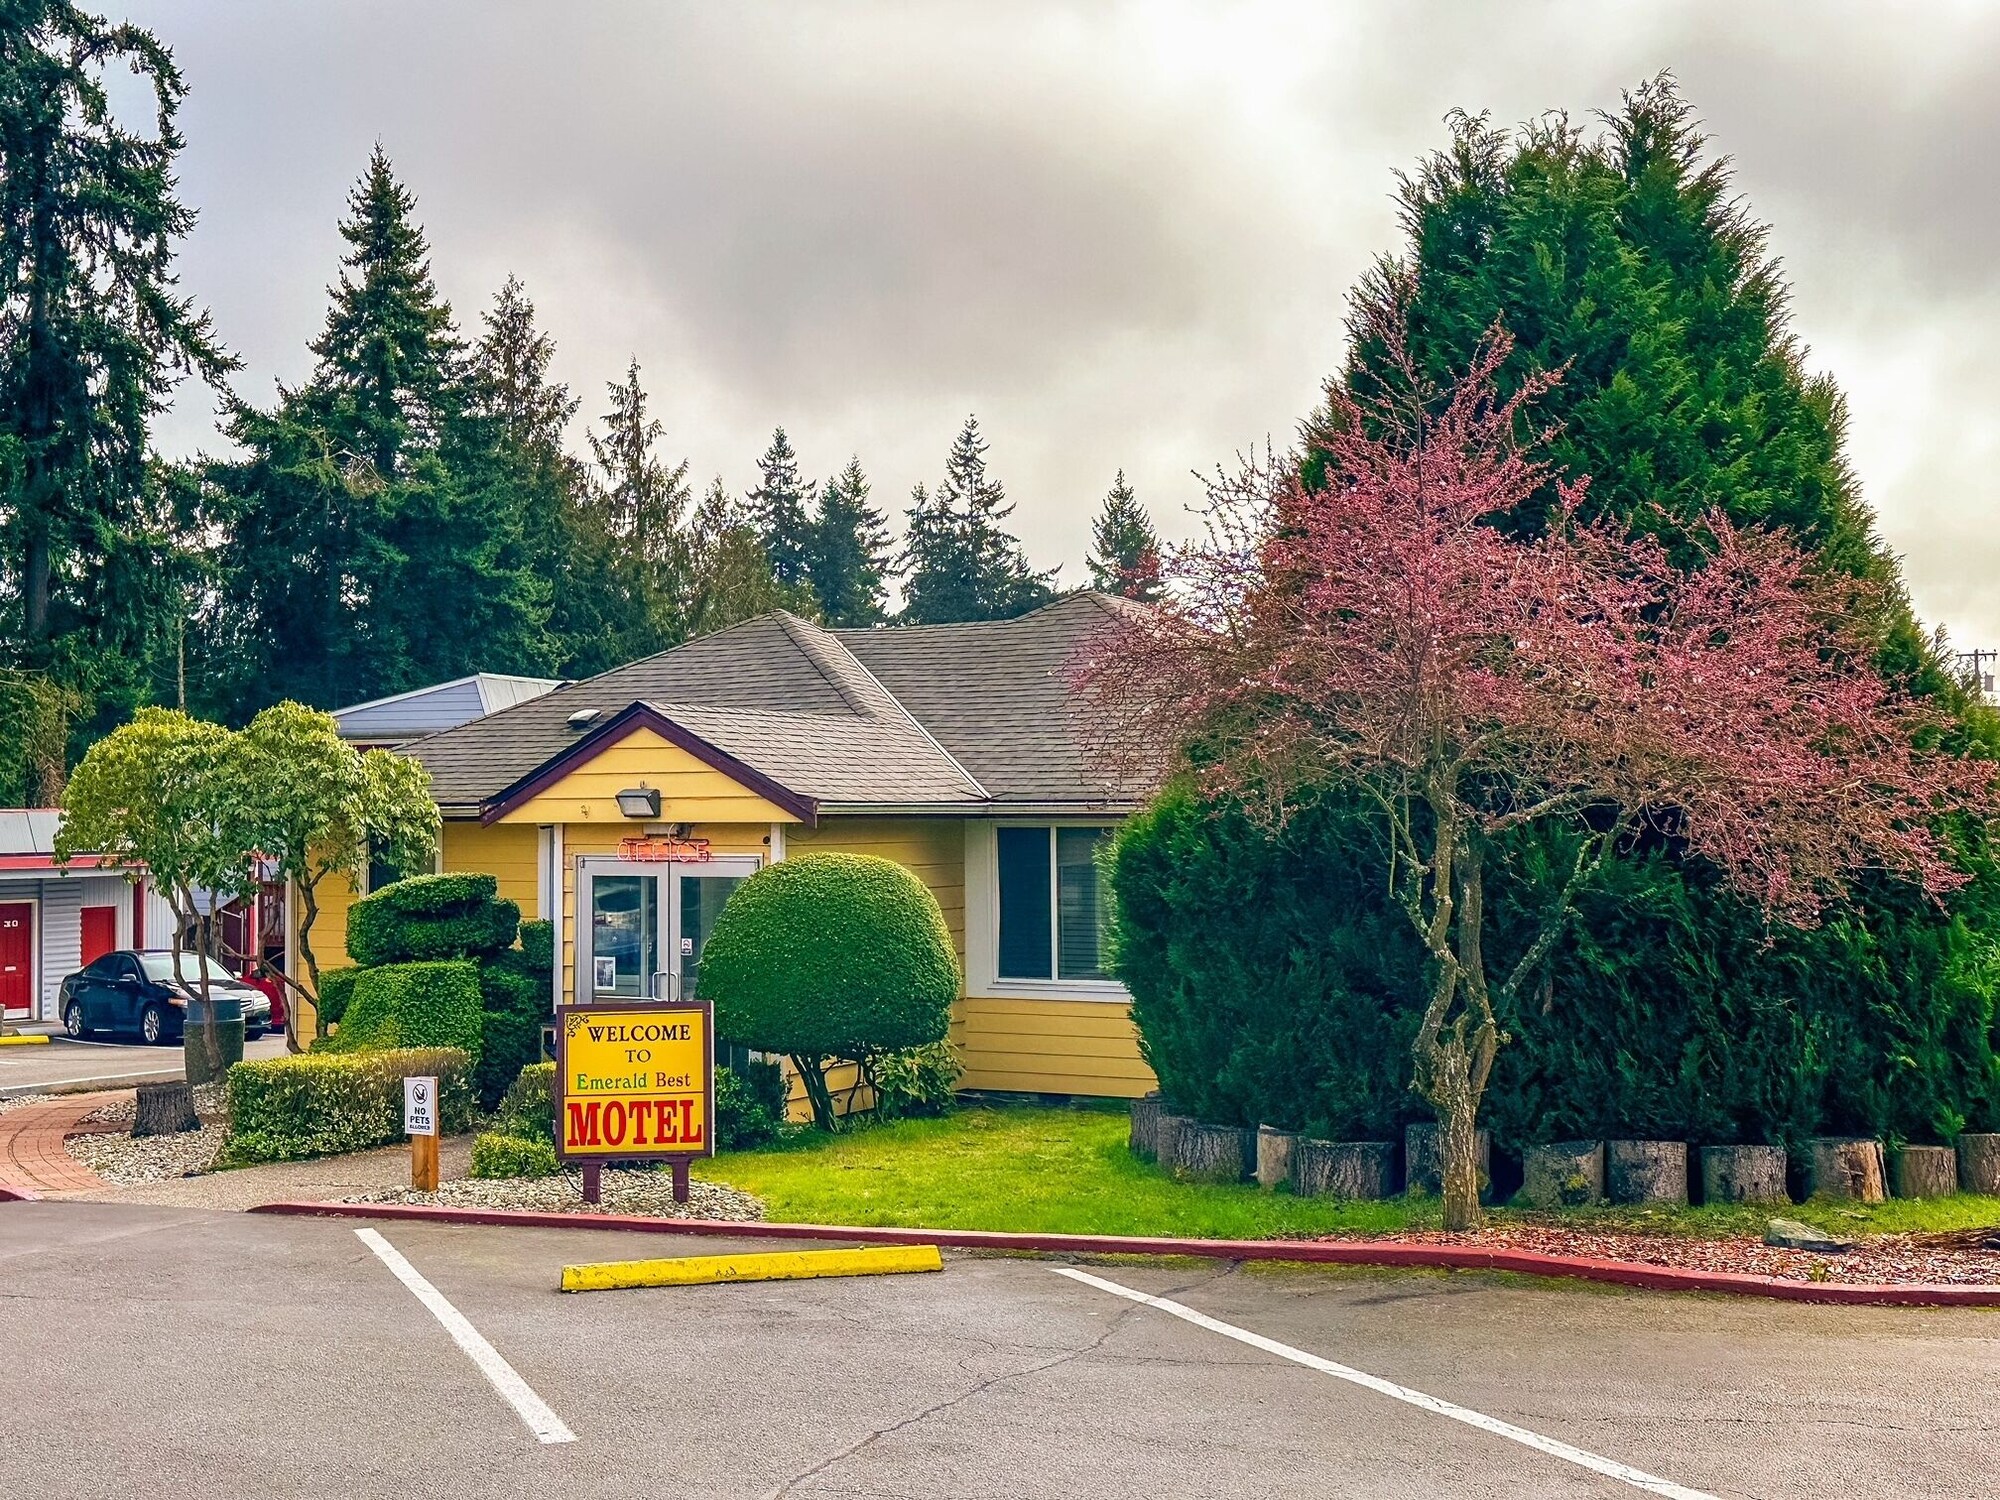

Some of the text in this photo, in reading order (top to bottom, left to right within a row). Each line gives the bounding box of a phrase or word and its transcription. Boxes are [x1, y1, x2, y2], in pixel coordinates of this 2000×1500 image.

[588, 1024, 691, 1042] WELCOME
[625, 1049, 651, 1063] TO
[576, 1072, 691, 1090] Emerald Best
[414, 1106, 426, 1115] NO
[410, 1115, 430, 1124] PETS
[567, 1100, 702, 1147] MOTEL
